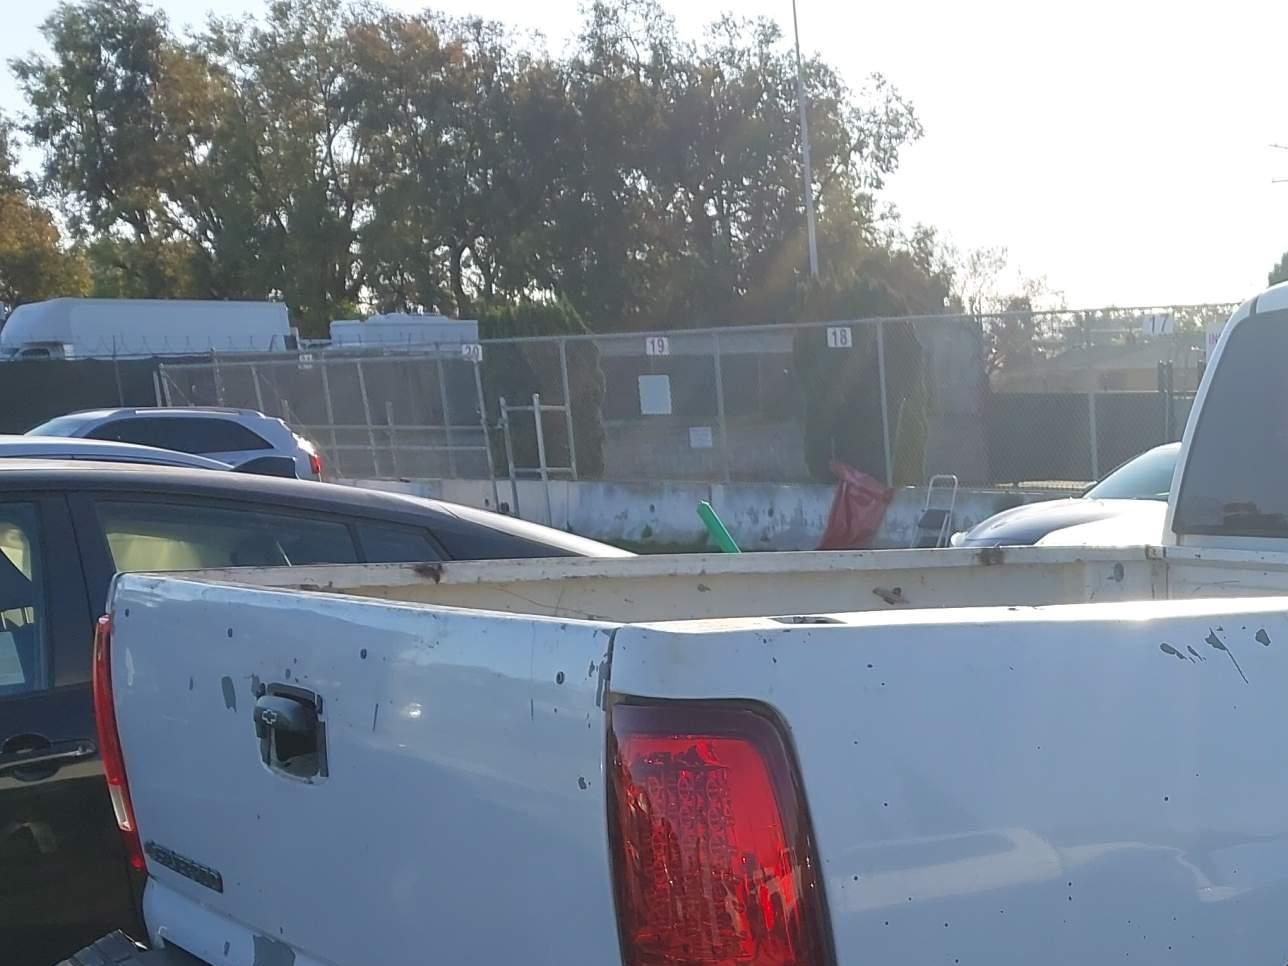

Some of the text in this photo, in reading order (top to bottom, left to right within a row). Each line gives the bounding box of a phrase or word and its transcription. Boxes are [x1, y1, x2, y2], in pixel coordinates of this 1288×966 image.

[1151, 313, 1169, 333] 17
[650, 339, 665, 353] 19
[832, 329, 848, 346] 18
